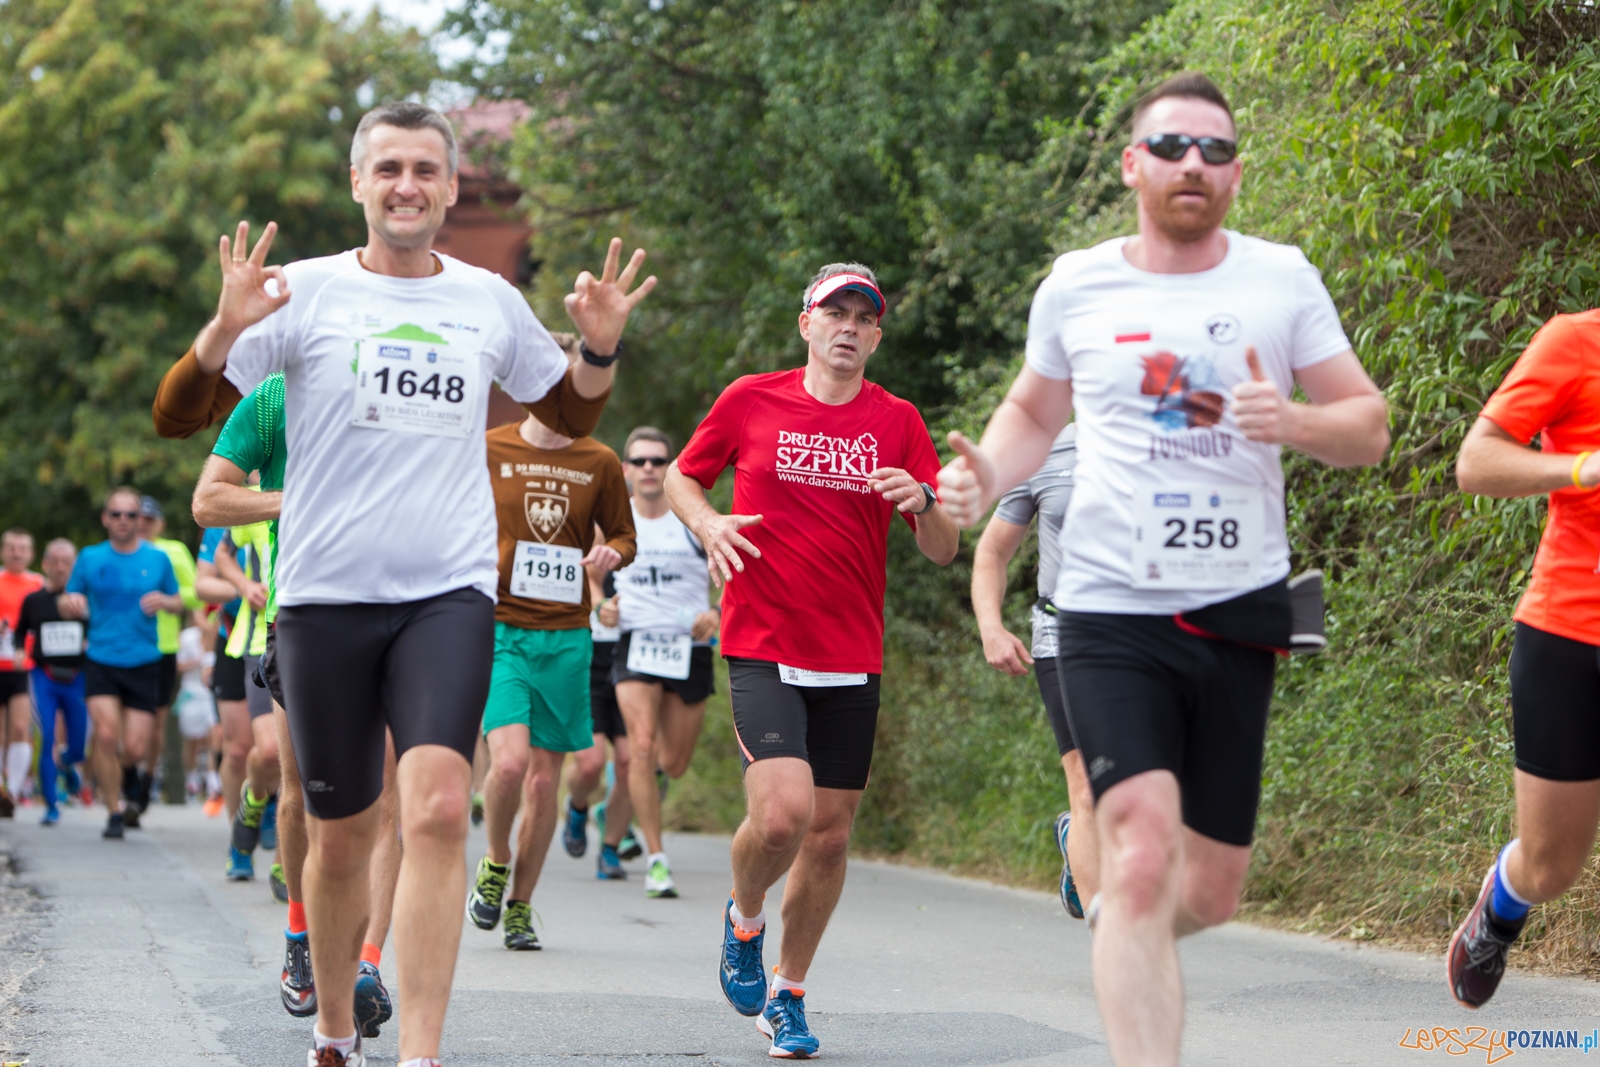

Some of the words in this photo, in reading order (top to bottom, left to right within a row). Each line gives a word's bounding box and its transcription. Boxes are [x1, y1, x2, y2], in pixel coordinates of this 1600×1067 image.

[374, 367, 465, 403] 1648
[777, 430, 862, 454] DRUŻYNA
[528, 463, 551, 473] BIEG
[775, 446, 879, 478] SZPIKU
[777, 472, 872, 495] www.darszpiku.pl
[1163, 518, 1240, 549] 258
[523, 559, 576, 582] 1918
[639, 645, 682, 662] 1156
